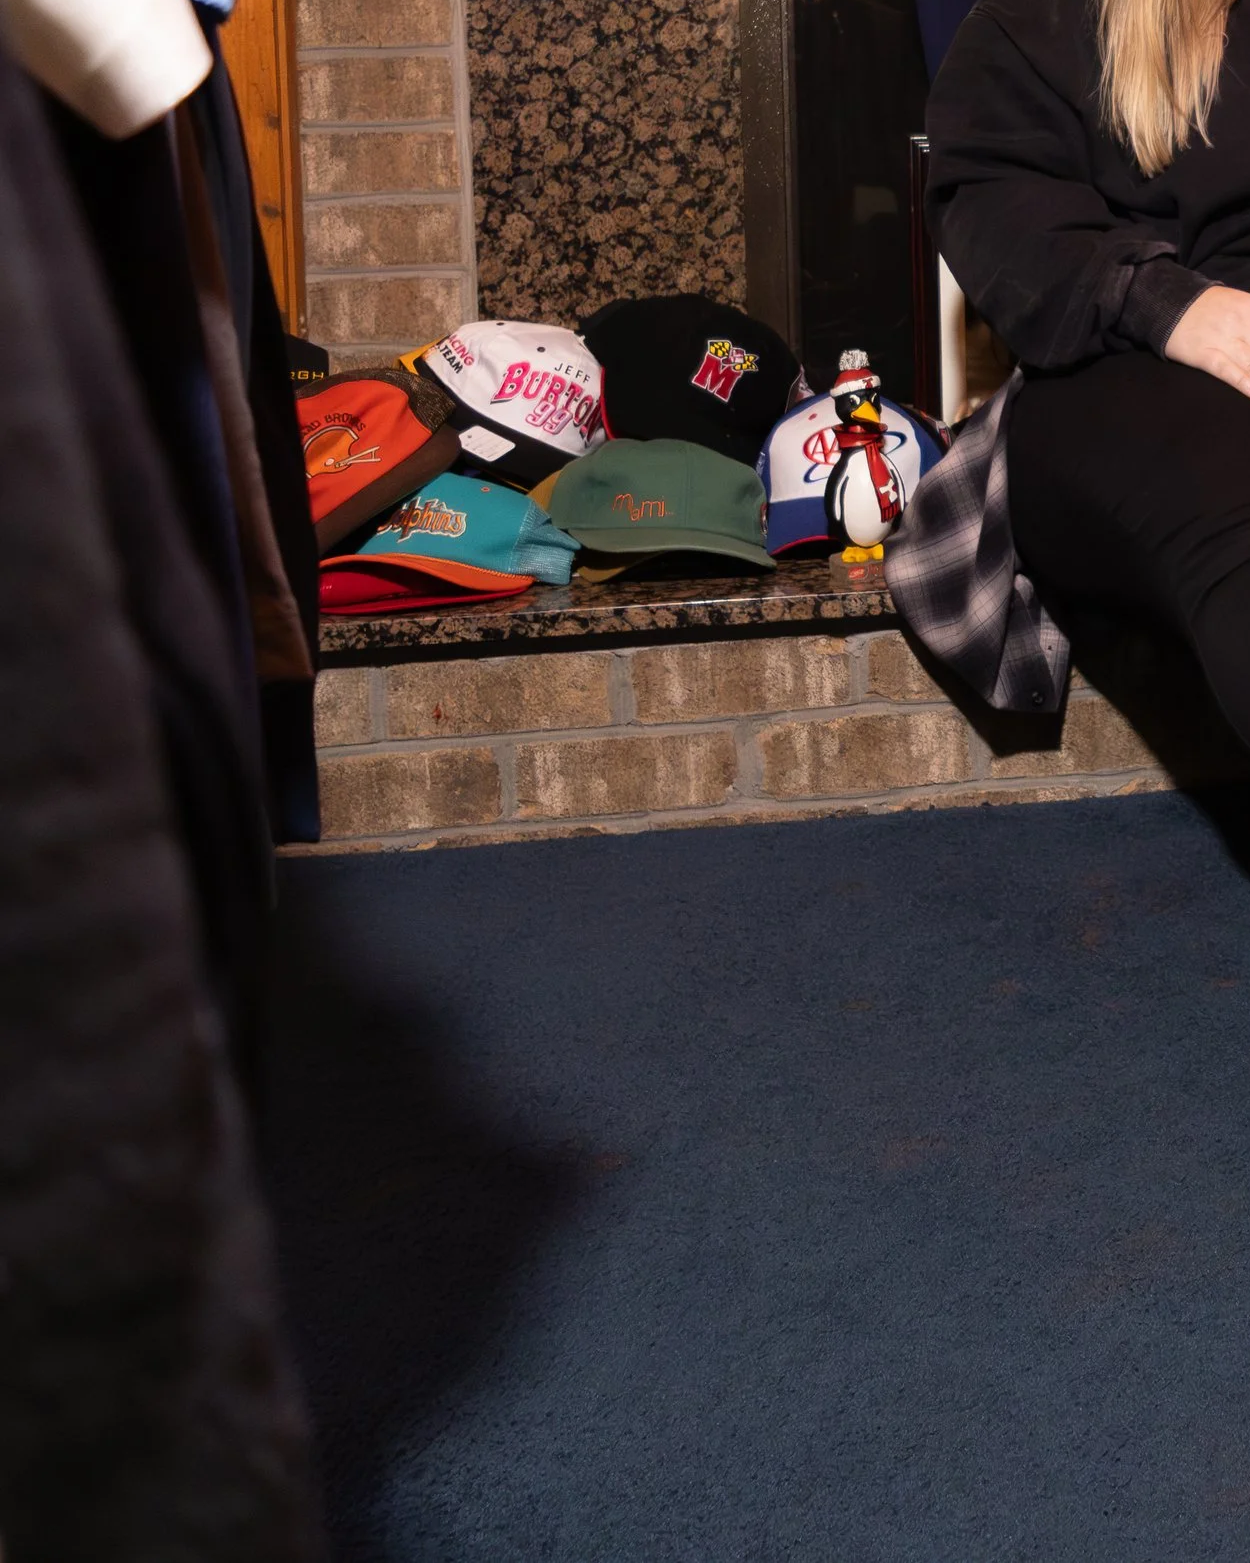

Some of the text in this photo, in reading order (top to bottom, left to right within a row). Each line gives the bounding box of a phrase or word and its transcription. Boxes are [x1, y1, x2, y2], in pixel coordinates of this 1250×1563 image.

[440, 344, 464, 375] TEAM
[554, 362, 591, 383] JEFF
[691, 351, 742, 403] M
[490, 361, 602, 444] BURTON
[524, 403, 573, 435] 99
